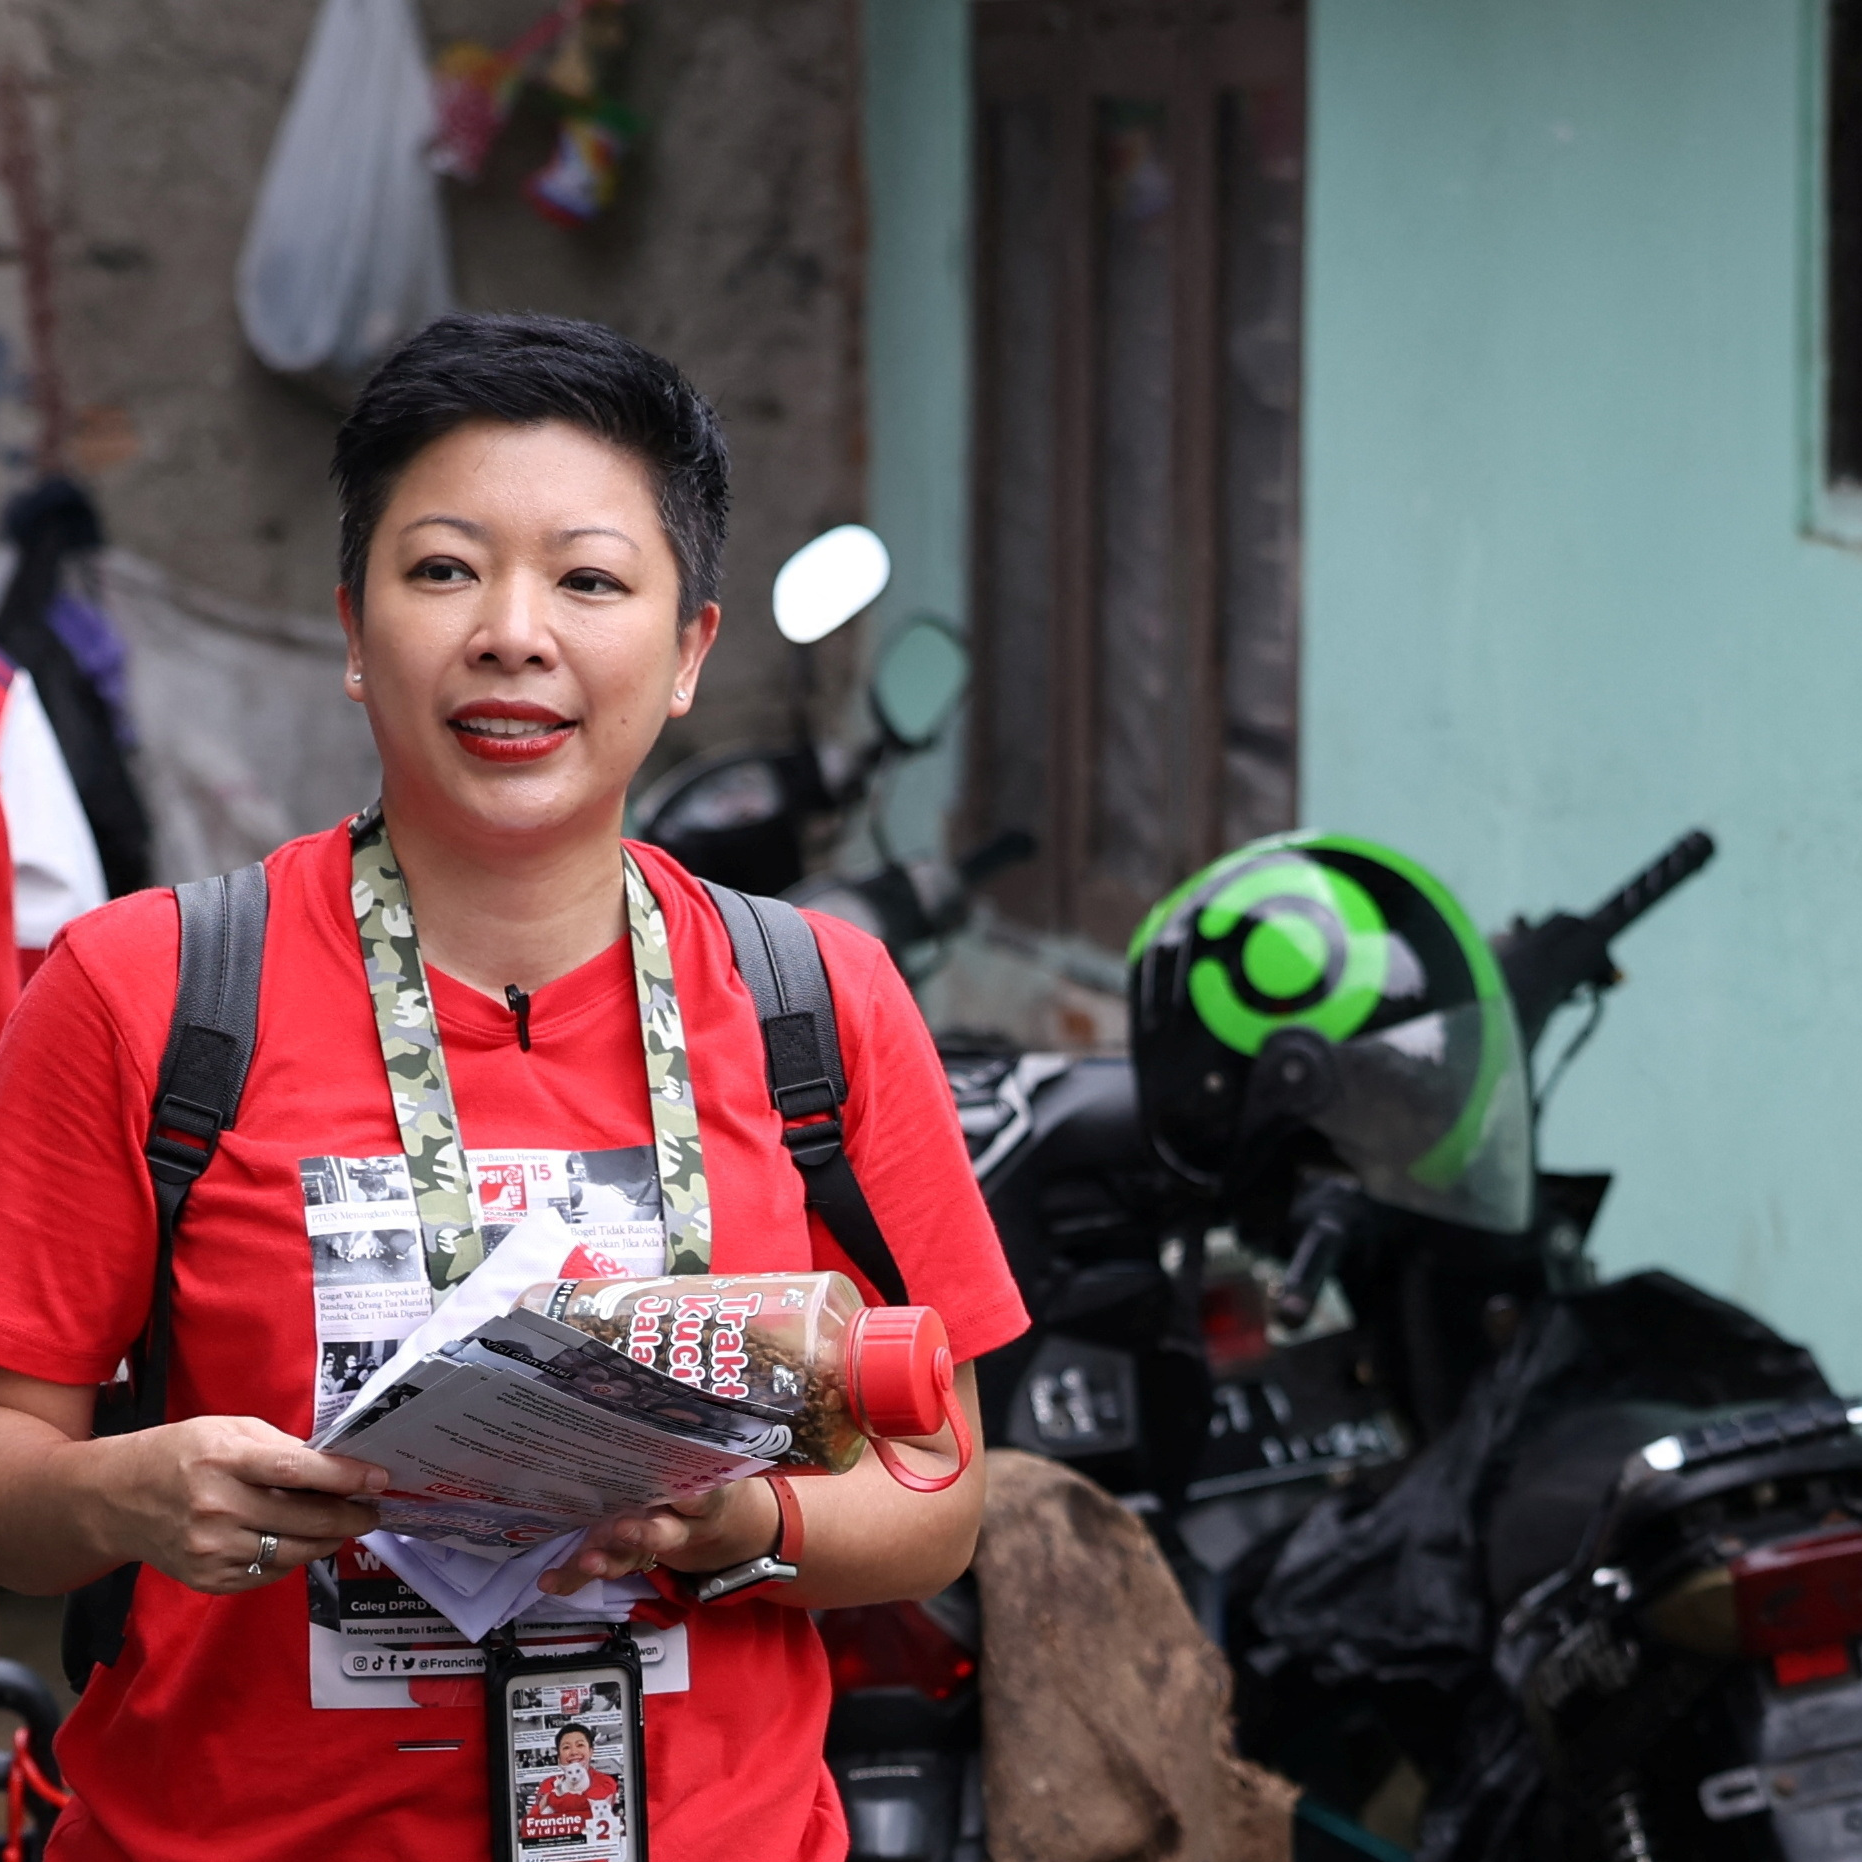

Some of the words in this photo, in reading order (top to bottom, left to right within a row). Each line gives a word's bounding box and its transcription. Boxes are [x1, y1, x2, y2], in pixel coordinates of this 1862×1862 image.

[488, 1153, 515, 1162] Bantu
[518, 1153, 549, 1161] Hewan
[477, 1169, 502, 1185] PSI
[530, 1164, 552, 1181] 15
[311, 1212, 337, 1223] PTUN
[339, 1209, 390, 1220] Menangkan
[570, 1226, 596, 1237] Bogel
[599, 1225, 625, 1236] Tidak
[628, 1225, 661, 1235] Rabies,
[622, 1238, 640, 1250] Jika
[642, 1238, 660, 1248] Ada
[319, 1292, 342, 1302] Gugat
[344, 1291, 363, 1299] Wali
[365, 1290, 383, 1298] Kota
[384, 1288, 409, 1299] Depok
[411, 1287, 419, 1296] ke
[320, 1302, 356, 1311] Bandung,
[358, 1301, 382, 1310] Orang
[384, 1300, 398, 1308] Tua
[400, 1298, 423, 1307] Murid
[320, 1312, 349, 1321] Pondok
[350, 1312, 369, 1320] Cina
[377, 1310, 398, 1319] Tidak
[401, 1309, 430, 1319] Digusur
[629, 1296, 670, 1364] Jala
[712, 1293, 762, 1399] Trakt
[513, 1349, 541, 1368] dan
[542, 1361, 573, 1379] misi
[429, 1482, 494, 1502] Cerah
[503, 1524, 556, 1543] 2
[350, 1601, 386, 1613] Caleg
[389, 1600, 427, 1610] DPRD
[346, 1626, 395, 1637] Kebayoran
[397, 1625, 420, 1634] Baru
[580, 1687, 589, 1697] 15
[526, 1814, 582, 1828] Francine
[526, 1825, 580, 1836] Widjojo
[596, 1820, 610, 1840] 2
